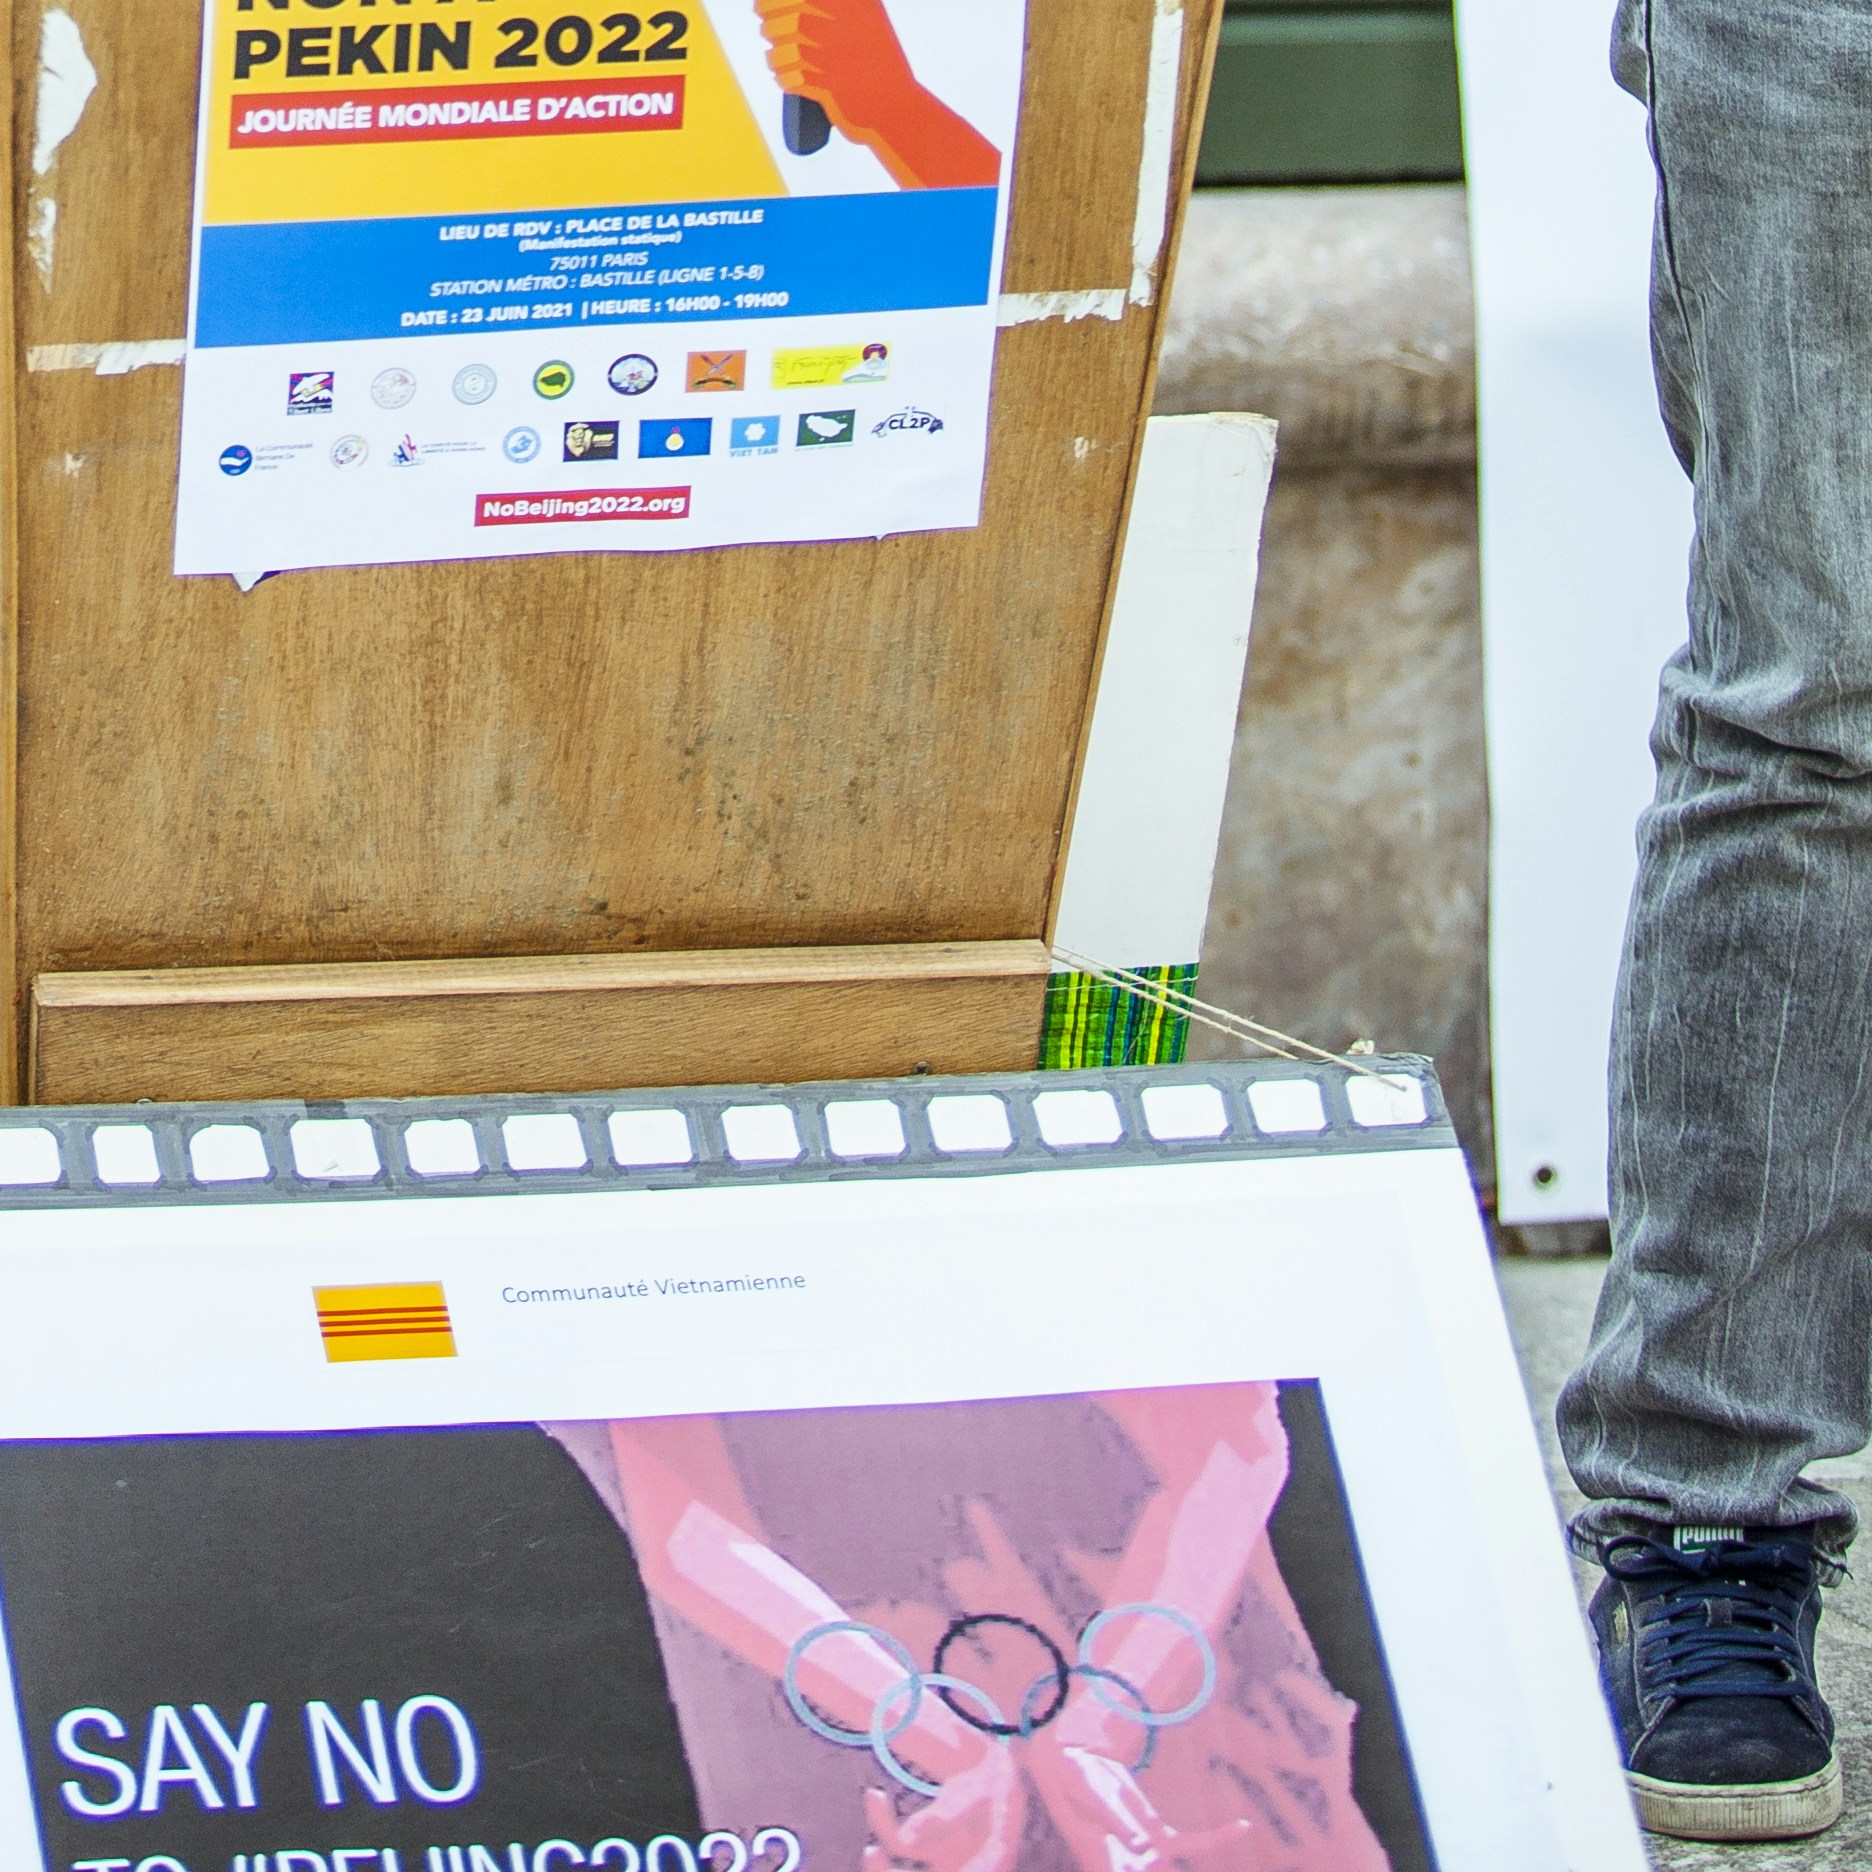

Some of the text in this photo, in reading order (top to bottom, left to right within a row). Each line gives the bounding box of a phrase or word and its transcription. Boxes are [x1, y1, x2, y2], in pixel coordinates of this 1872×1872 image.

[233, 10, 689, 80] PEKIN 2022
[237, 92, 674, 134] JOURNÉE MONDIALE D'ACTION
[439, 225, 480, 241] LIEU
[483, 222, 510, 238] DE
[513, 220, 552, 237] RDV
[565, 216, 623, 234] PLACE
[626, 214, 653, 231] DE
[656, 213, 680, 229] LA
[683, 209, 765, 228] BASTILLE
[549, 251, 649, 272] 75011 PARIS
[429, 278, 504, 297] STATION
[505, 274, 569, 292] MÉTRO
[579, 269, 657, 288] BASTILLE
[657, 266, 716, 286] (LIGNE
[400, 309, 448, 327] DATE
[460, 307, 484, 324] 23
[485, 305, 529, 322] JUIN
[531, 302, 573, 320] 2021
[590, 298, 652, 316] HEURE
[664, 295, 721, 312] 16H00
[732, 291, 790, 309] 19H00
[887, 416, 930, 431] CL2P
[482, 495, 686, 518] NoBeijing2022.org
[502, 1274, 807, 1303] Communauté Vietnamienne
[54, 1694, 479, 1818] SAY NO
